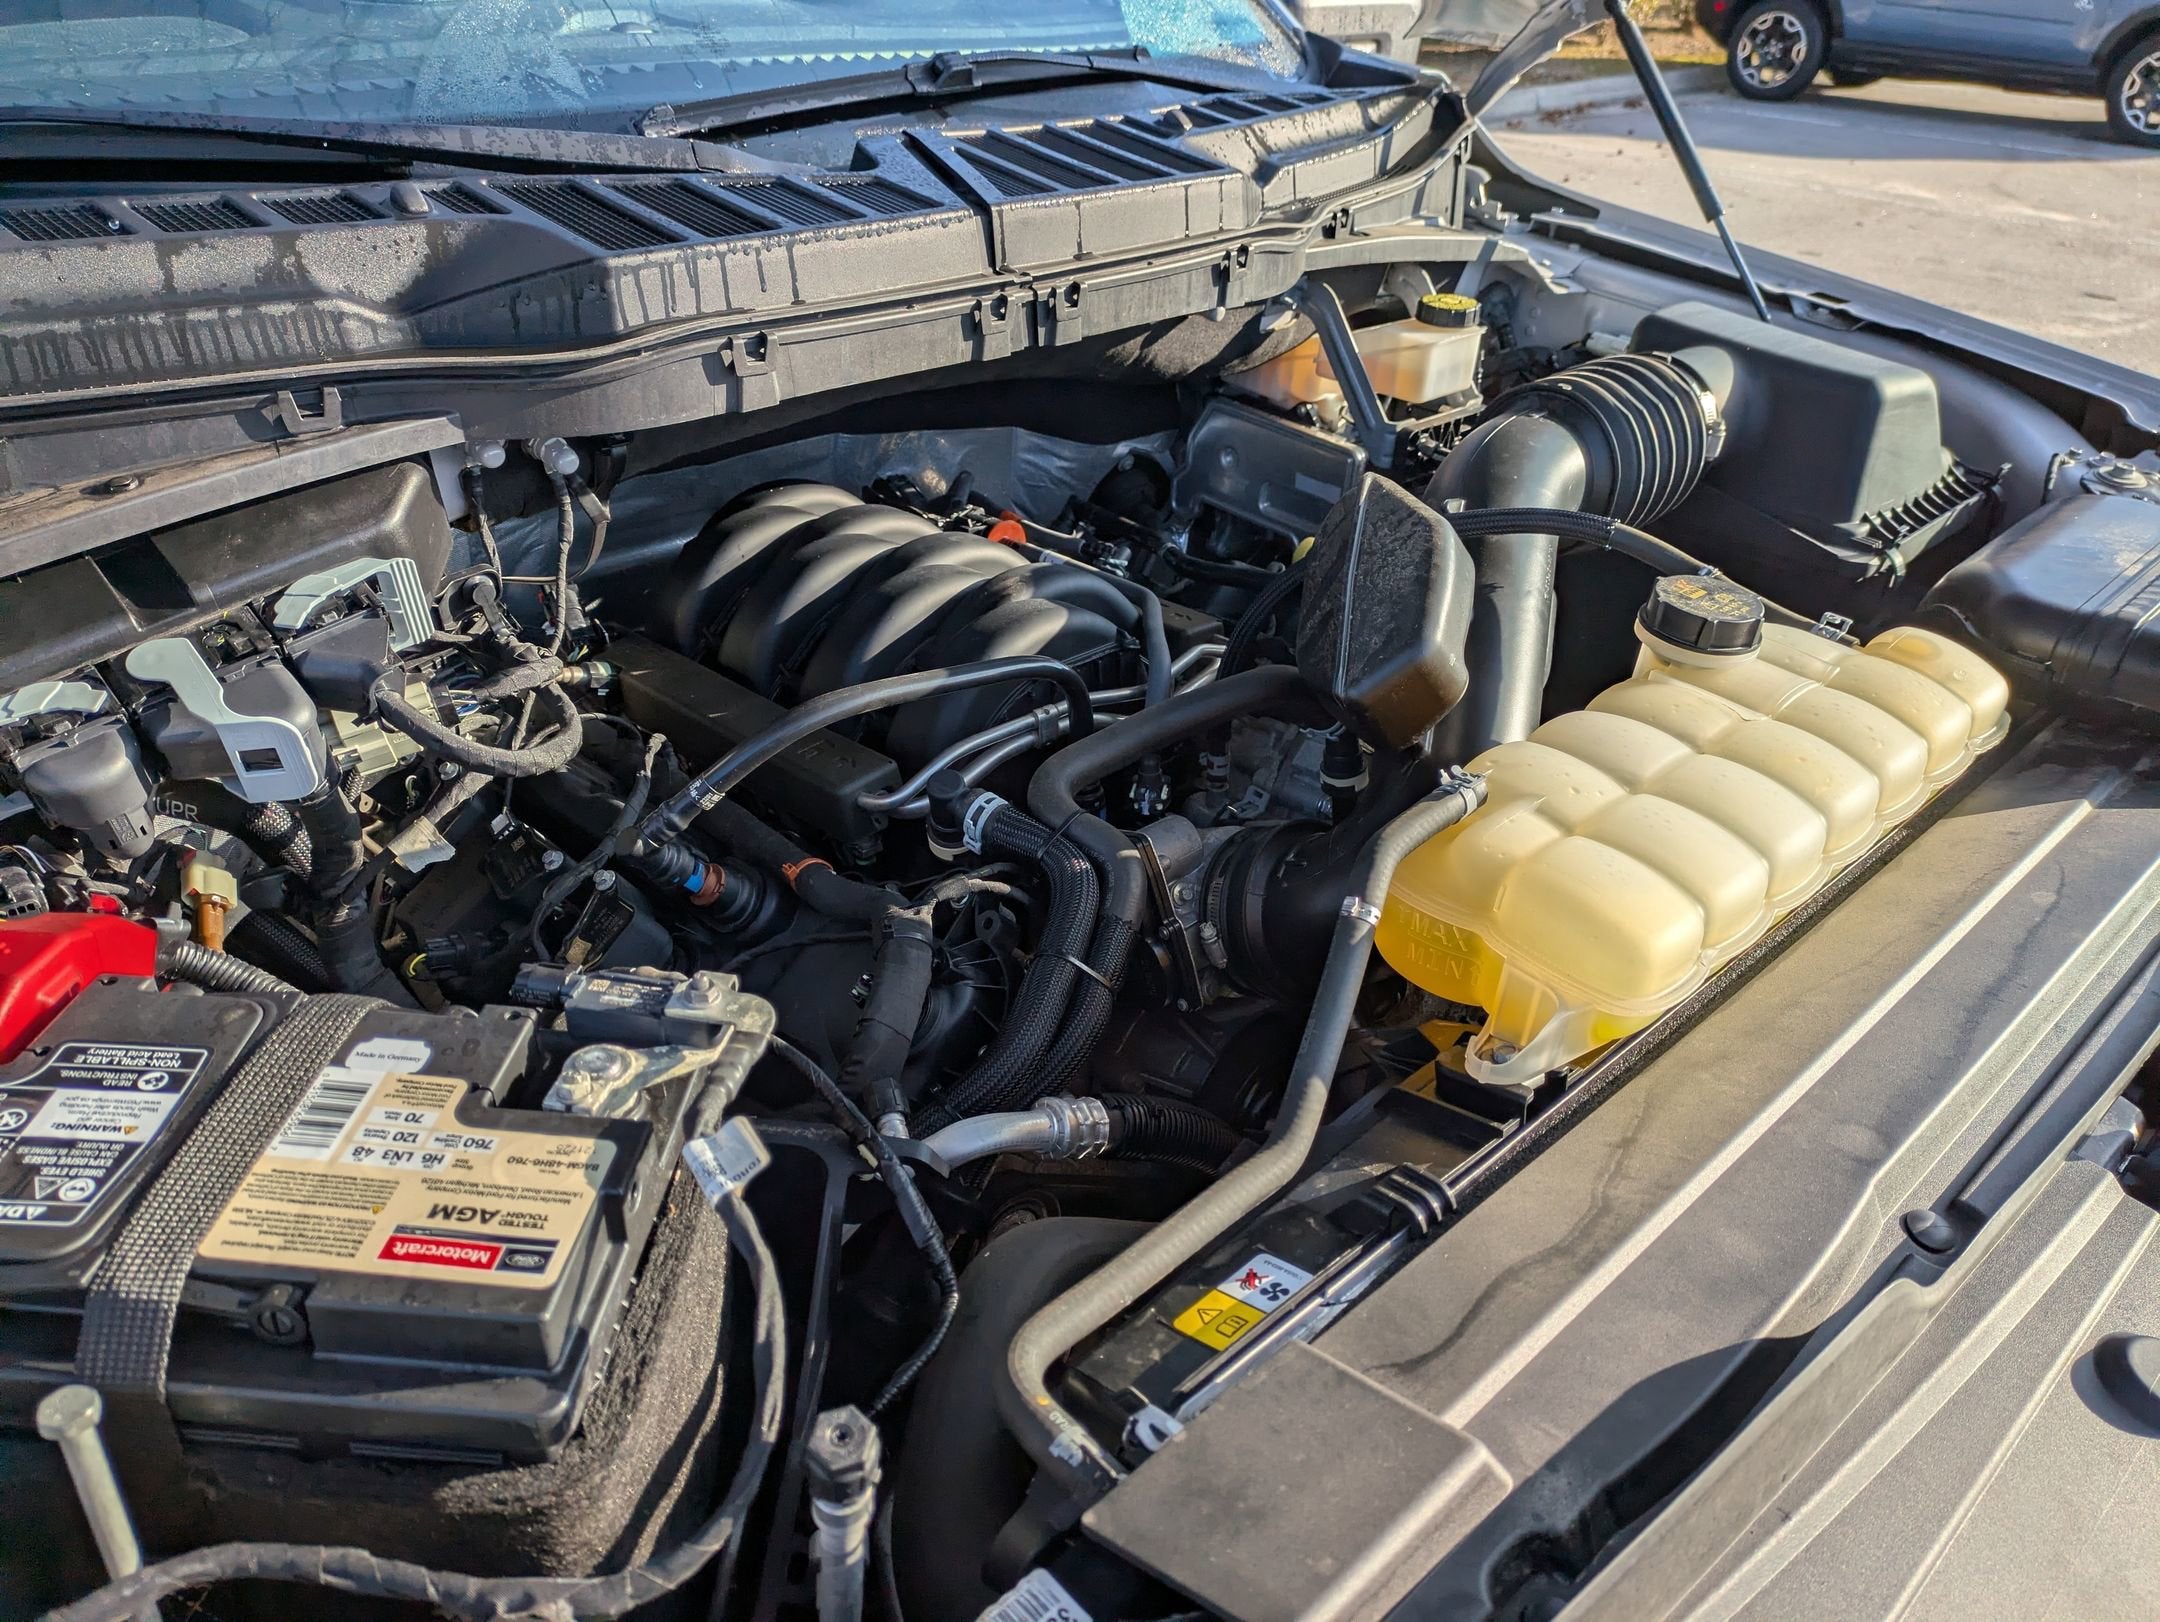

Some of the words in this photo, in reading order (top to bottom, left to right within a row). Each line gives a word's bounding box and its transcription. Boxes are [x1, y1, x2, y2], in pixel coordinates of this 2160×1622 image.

[153, 796, 200, 822] UPR
[1406, 942, 1464, 980] MIN
[87, 1047, 126, 1058] Battery
[128, 1050, 152, 1059] Acid
[153, 1051, 180, 1060] Lead
[74, 1055, 182, 1068] NON-SPILLABLE
[387, 1054, 422, 1063] Germany
[60, 1070, 138, 1080] INSTRUCTIONS.
[404, 1112, 425, 1124] 70
[51, 1122, 122, 1134] WARNING:
[392, 1131, 420, 1144] 120
[76, 1141, 109, 1150] INJURY.
[109, 1143, 125, 1151] OR
[462, 1137, 495, 1150] 760
[16, 1146, 69, 1156] BLINDNESS
[68, 1148, 99, 1157] CAUSE
[99, 1150, 119, 1158] CAN
[351, 1146, 375, 1158] 48
[382, 1149, 415, 1162] LN3
[22, 1155, 57, 1165] GASES
[58, 1156, 113, 1167] EXPLOSIVE
[421, 1153, 445, 1165] H6
[507, 1155, 600, 1172] BAGM-48H6-760
[40, 1166, 69, 1176] EYES.
[69, 1167, 106, 1177] SHIELD
[425, 1185, 462, 1195] Company
[444, 1179, 480, 1190] Michigan
[462, 1189, 485, 1198] Motor
[485, 1191, 504, 1199] Ford
[543, 1189, 579, 1199] American
[517, 1194, 571, 1205] Manufactured
[427, 1203, 501, 1225] AGM
[498, 1220, 545, 1231] TESTED
[391, 1241, 492, 1265] Motorcraft
